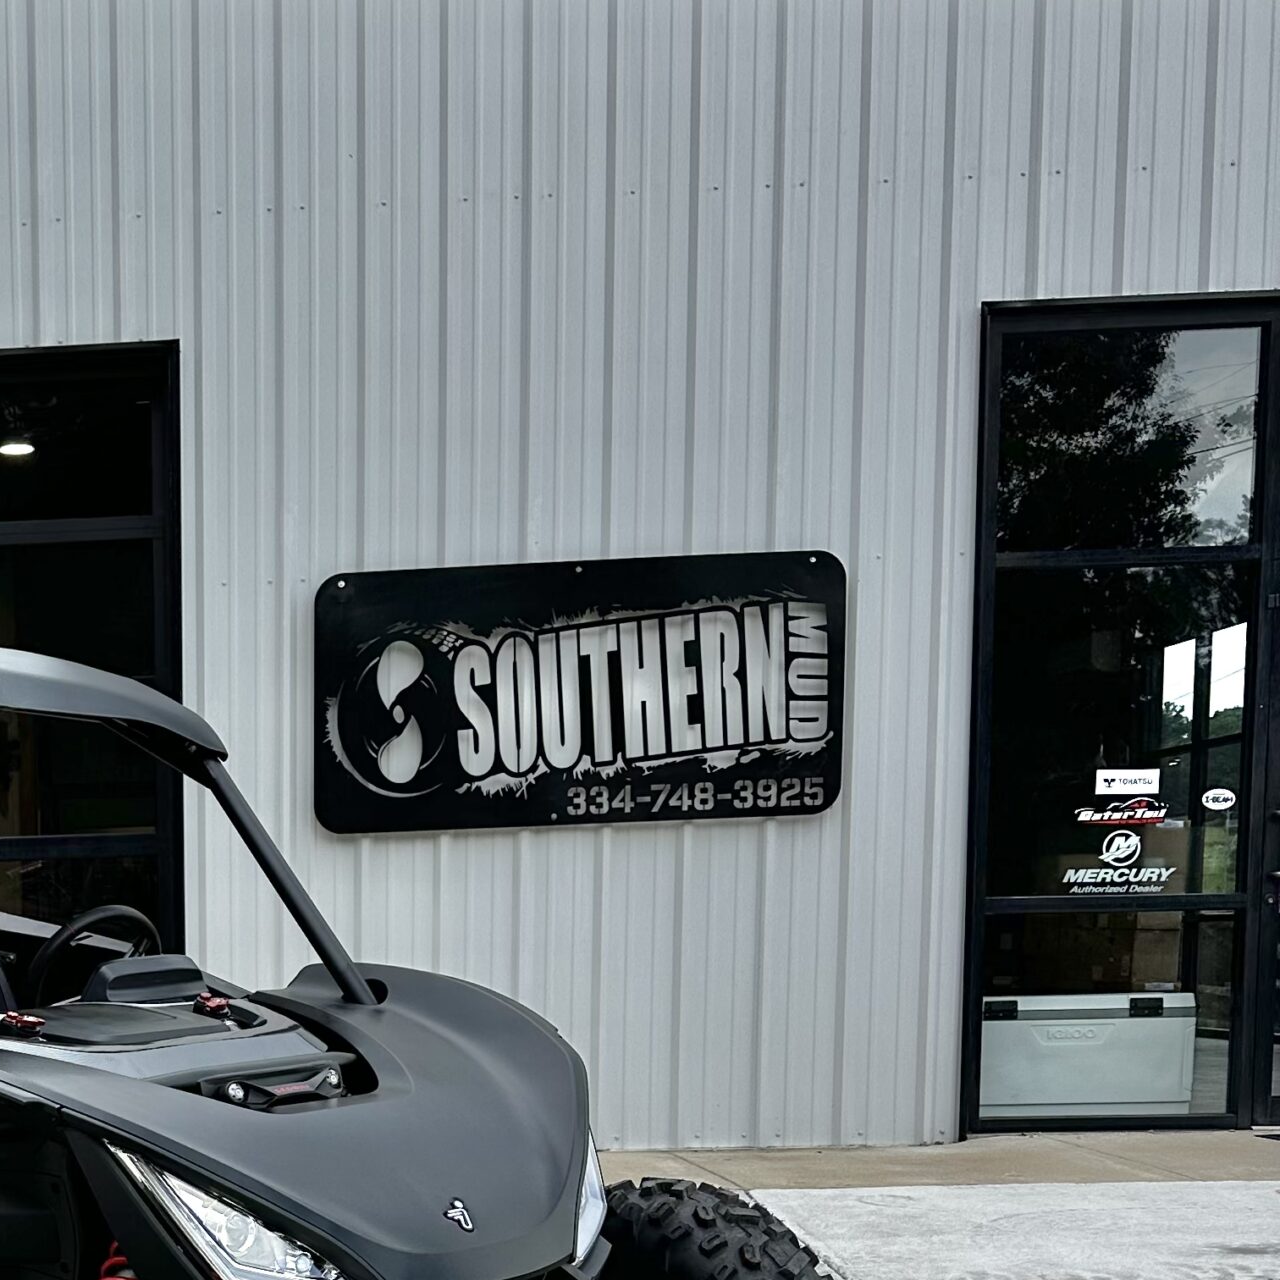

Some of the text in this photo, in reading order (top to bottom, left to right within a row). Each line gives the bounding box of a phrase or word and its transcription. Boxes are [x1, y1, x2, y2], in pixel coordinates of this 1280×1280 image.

[453, 602, 787, 777] SOUTHERN
[788, 601, 829, 740] MUD
[566, 777, 825, 817] 334-748-3925
[1062, 867, 1177, 884] MERCURY
[1069, 884, 1165, 894] Authorized Dealer
